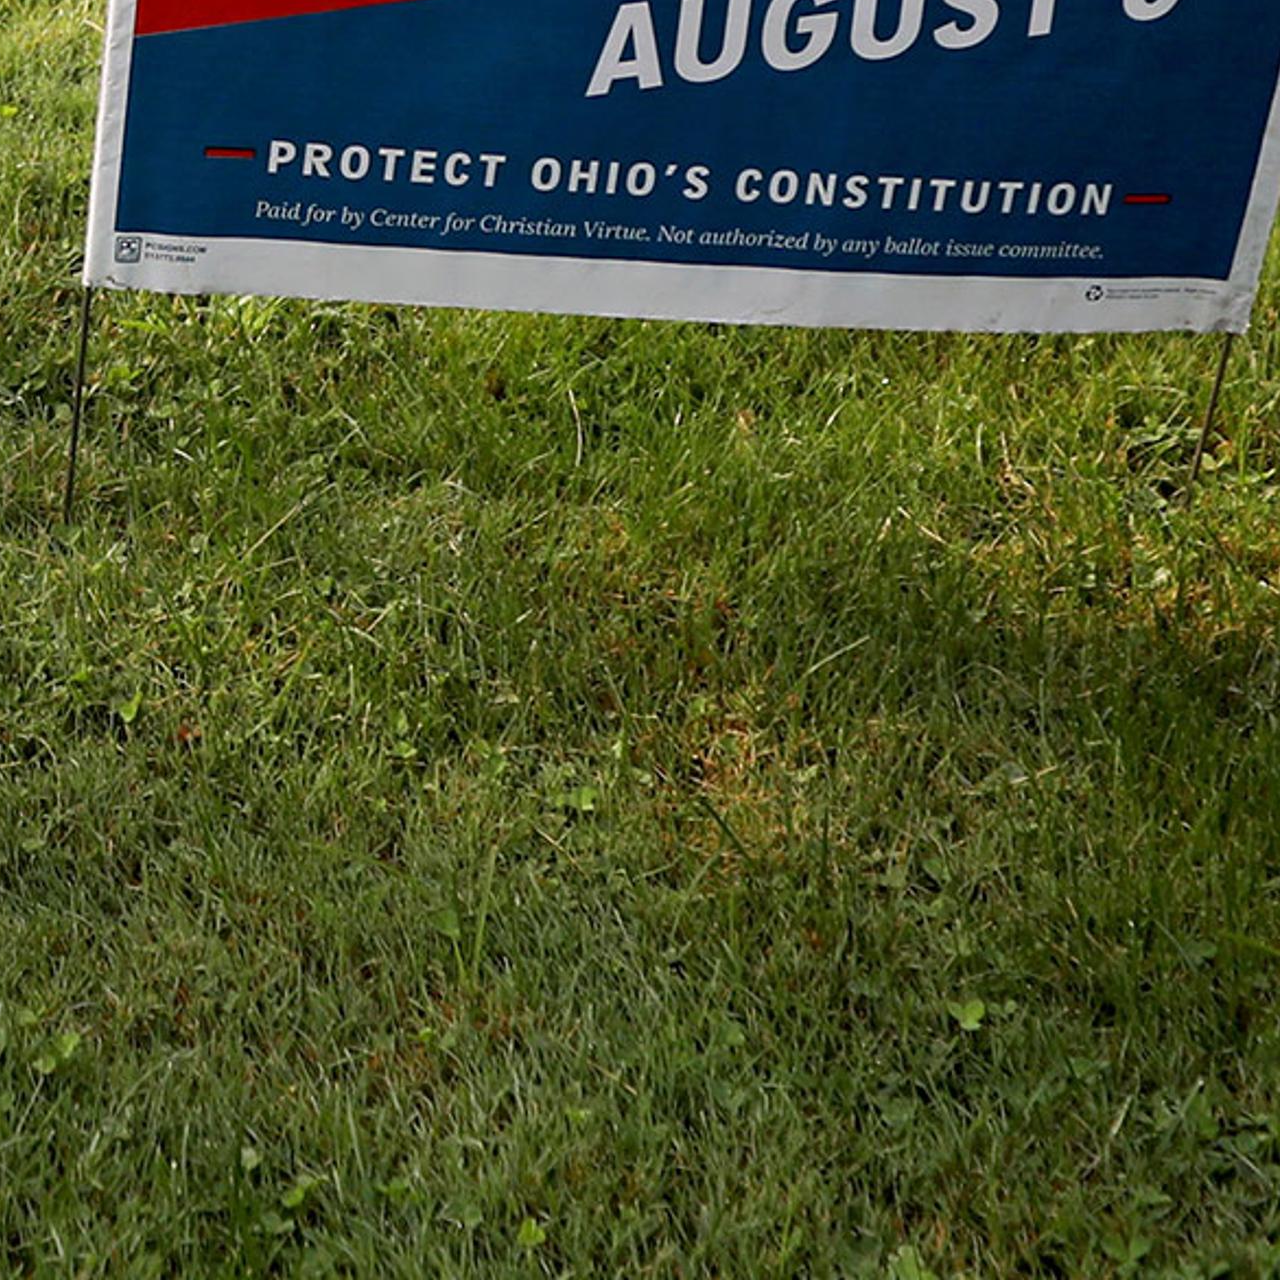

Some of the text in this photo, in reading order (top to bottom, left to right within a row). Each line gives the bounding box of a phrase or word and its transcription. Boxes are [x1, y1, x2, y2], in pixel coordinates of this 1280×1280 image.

[267, 140, 1113, 215] PROTECT OHIO'S CONSTITUTION
[255, 200, 1104, 259] Paid for by Center for Christian Virtue. Not authorized by any ballot issue committee.
